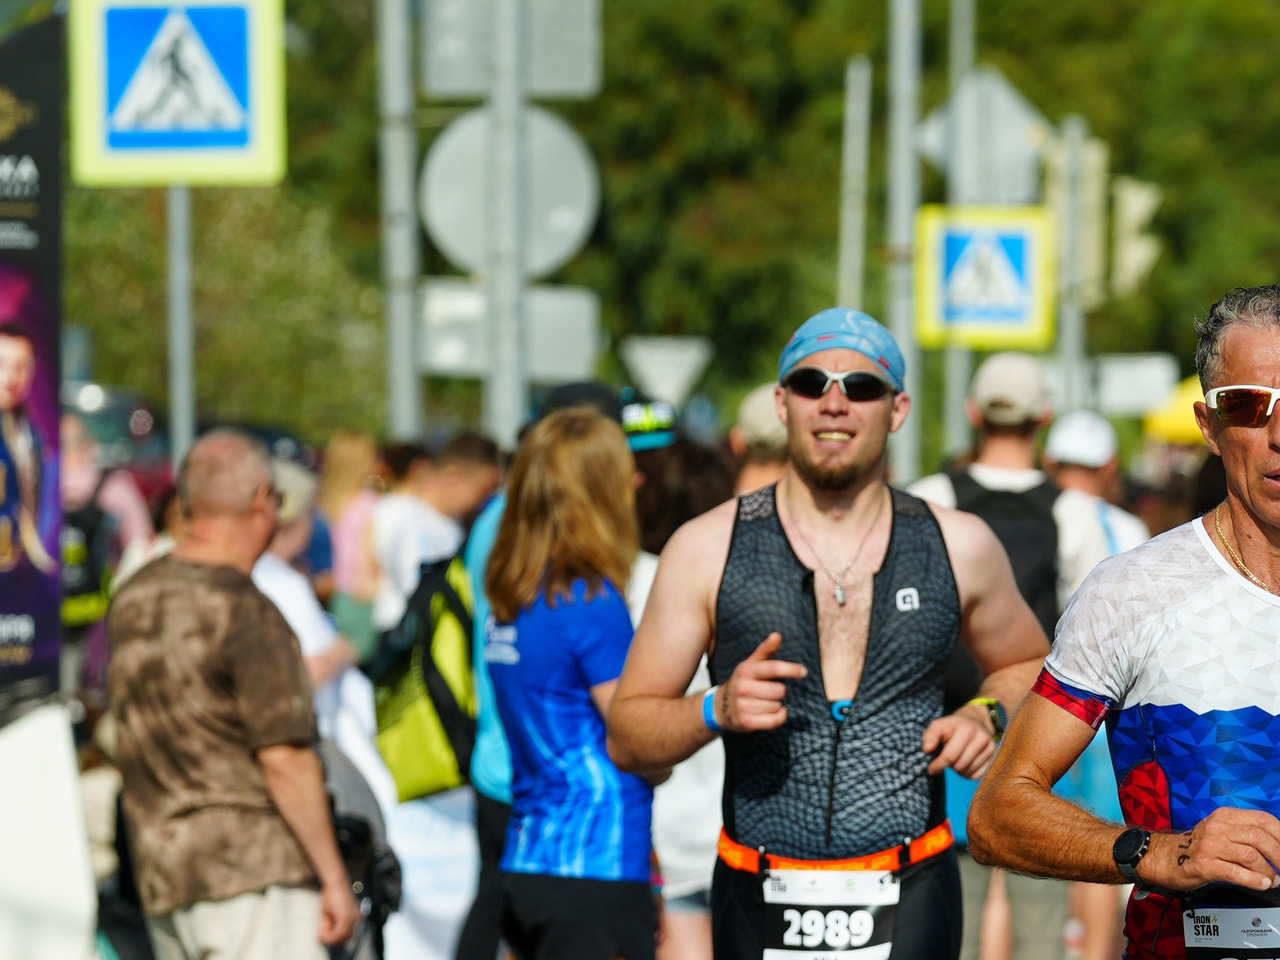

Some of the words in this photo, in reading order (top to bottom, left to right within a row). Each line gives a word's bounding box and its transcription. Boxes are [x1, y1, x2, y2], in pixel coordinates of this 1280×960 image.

[1193, 915, 1211, 924] IRON
[782, 908, 875, 948] 2989
[1193, 924, 1219, 937] STAR
